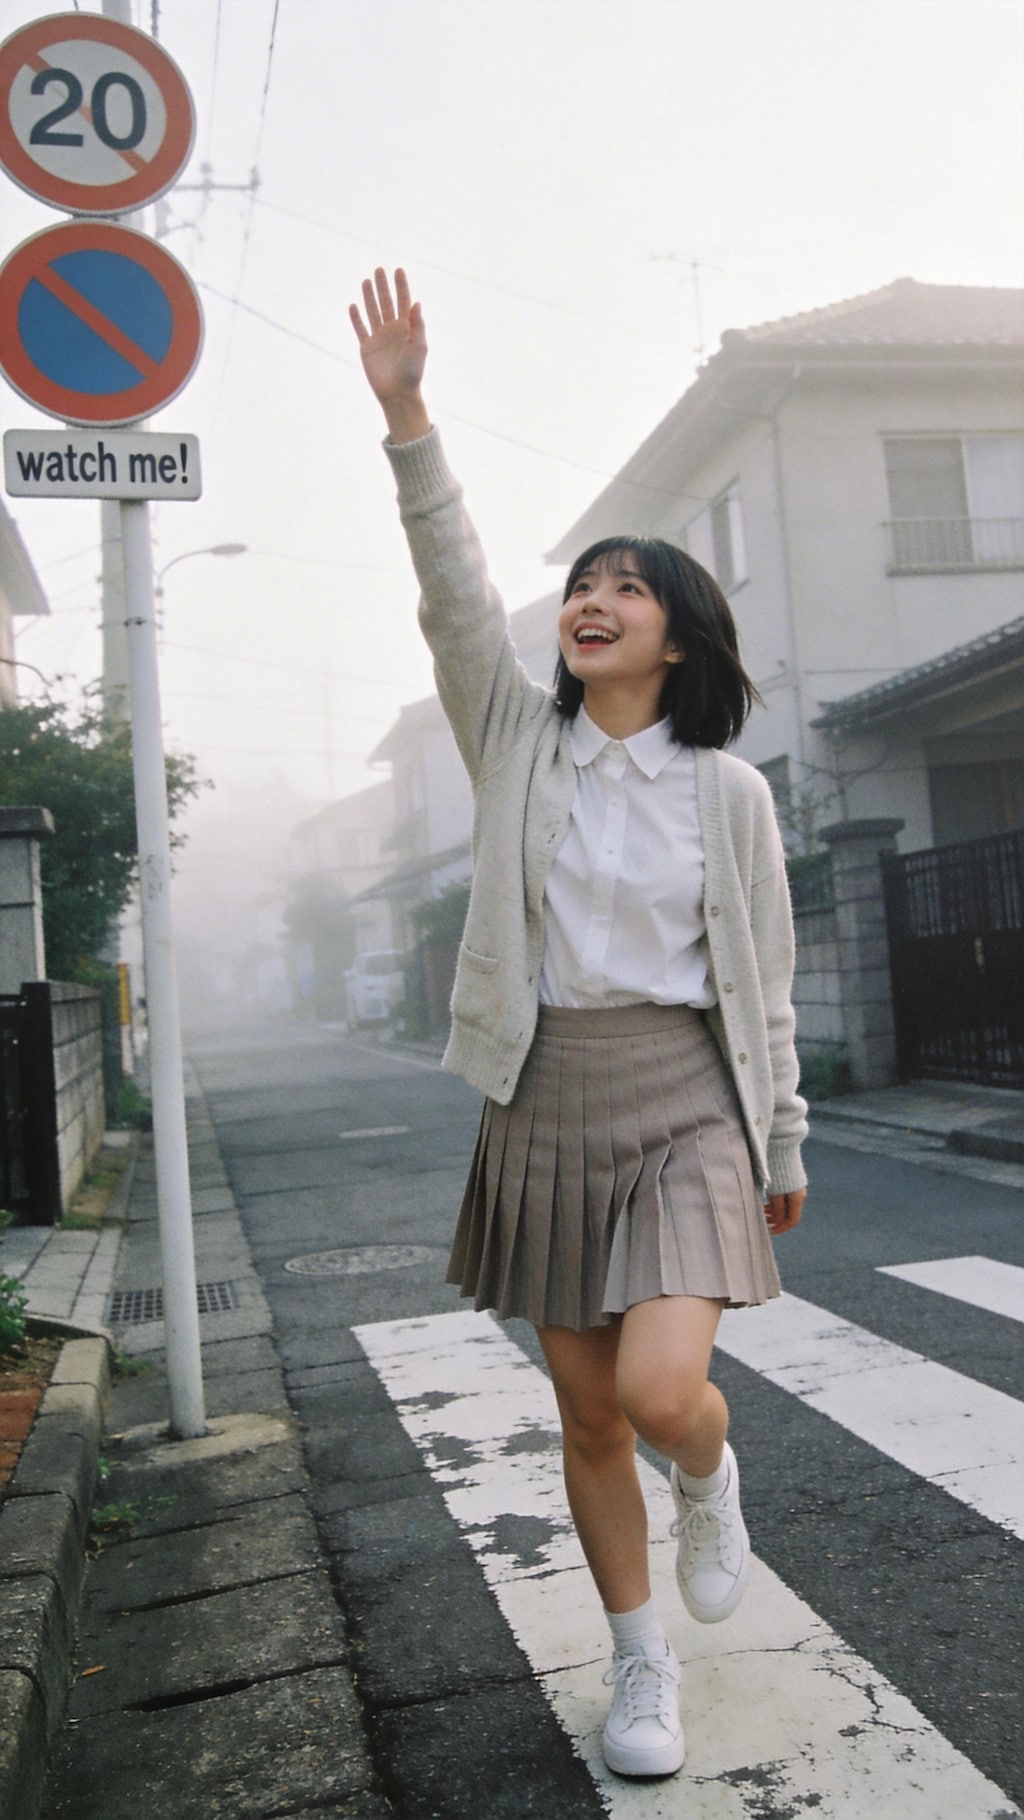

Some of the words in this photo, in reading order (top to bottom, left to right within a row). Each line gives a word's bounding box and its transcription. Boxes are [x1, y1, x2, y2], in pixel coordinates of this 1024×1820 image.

[29, 67, 147, 151] 20
[16, 441, 117, 483] watch
[128, 442, 189, 484] me!
